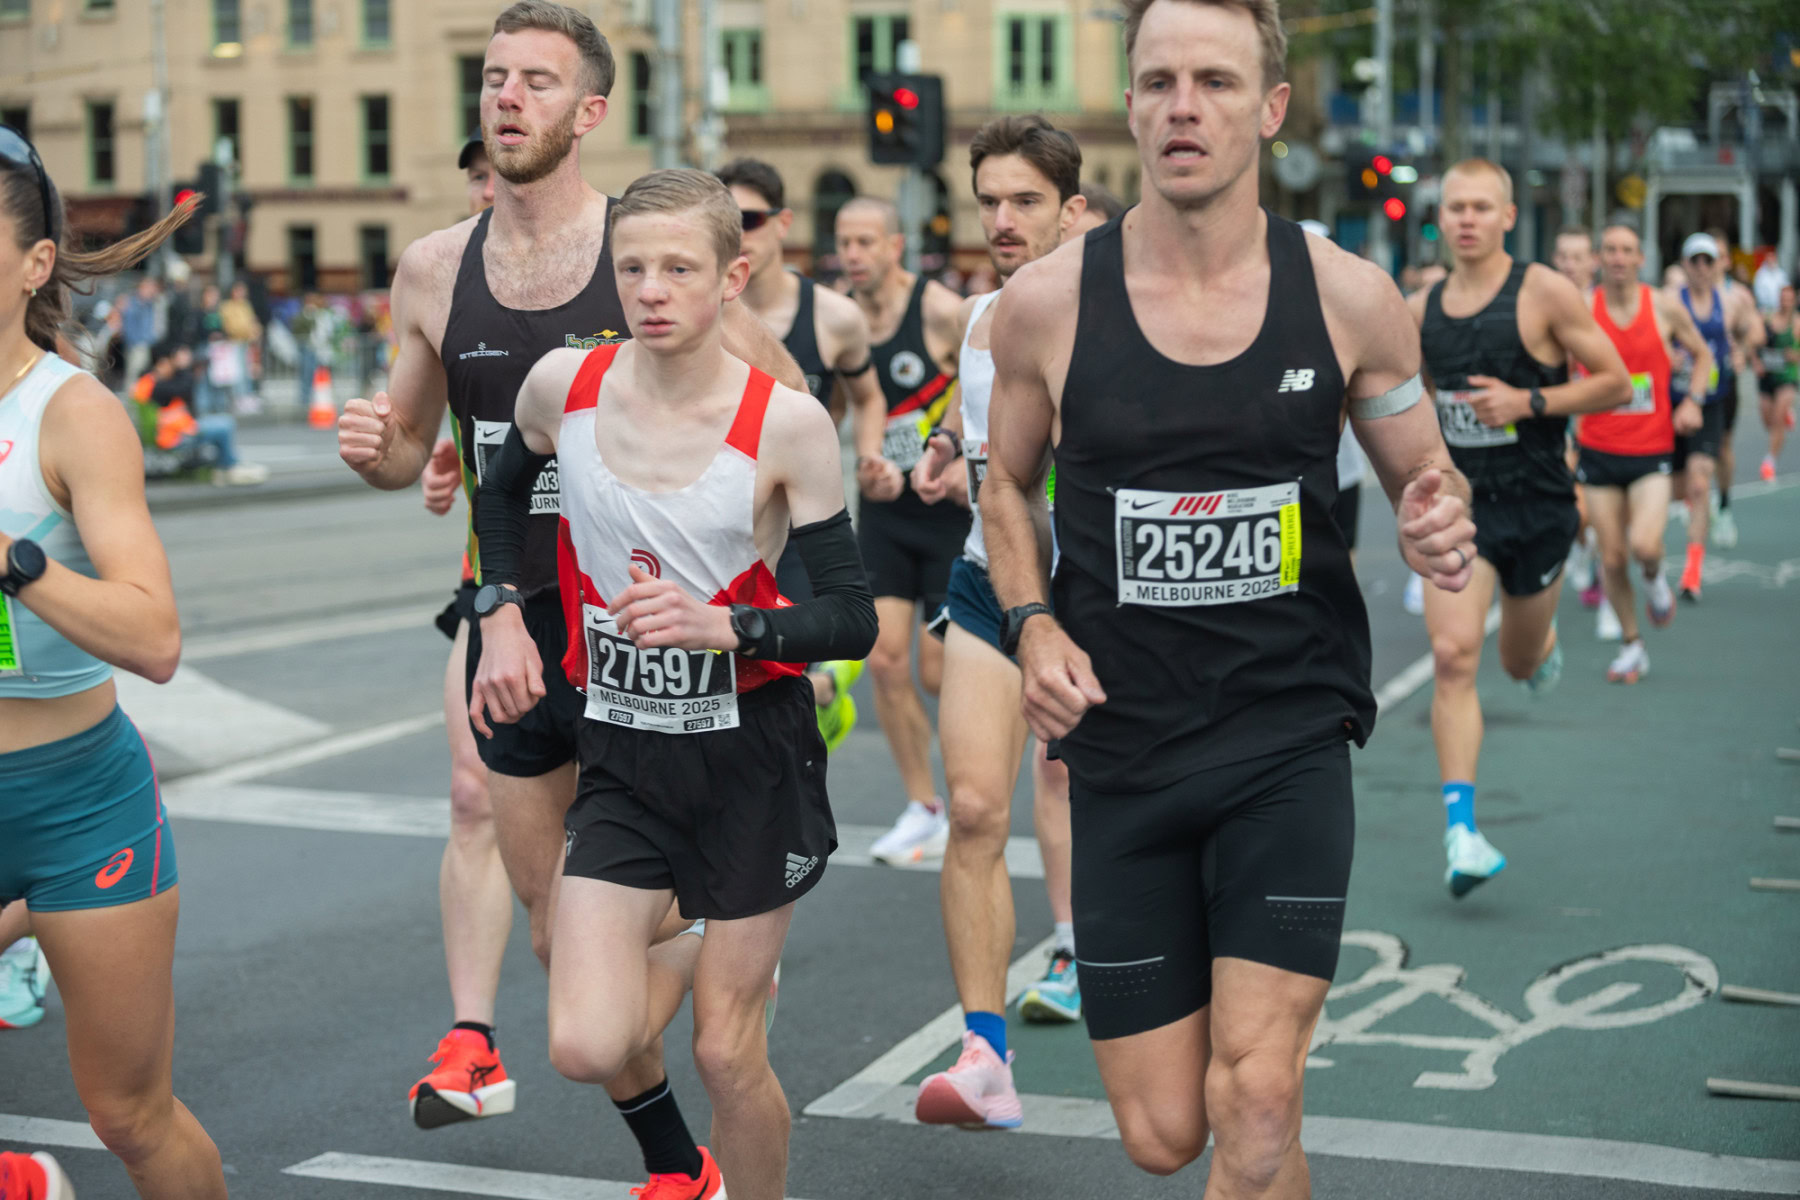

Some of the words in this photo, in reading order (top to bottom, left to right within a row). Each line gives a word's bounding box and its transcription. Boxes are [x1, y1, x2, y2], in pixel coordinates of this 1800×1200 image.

[459, 350, 509, 360] STEIGEN
[1287, 505, 1297, 556] PREFERRED
[1136, 517, 1281, 580] 25246
[1137, 584, 1235, 601] MELBOURNE
[1241, 578, 1281, 597] 2025
[599, 637, 715, 696] 27597
[600, 690, 677, 716] MELBOURNE
[682, 699, 721, 716] 2025
[610, 710, 632, 724] 27597
[687, 719, 712, 731] 27597
[785, 855, 819, 888] adidas
